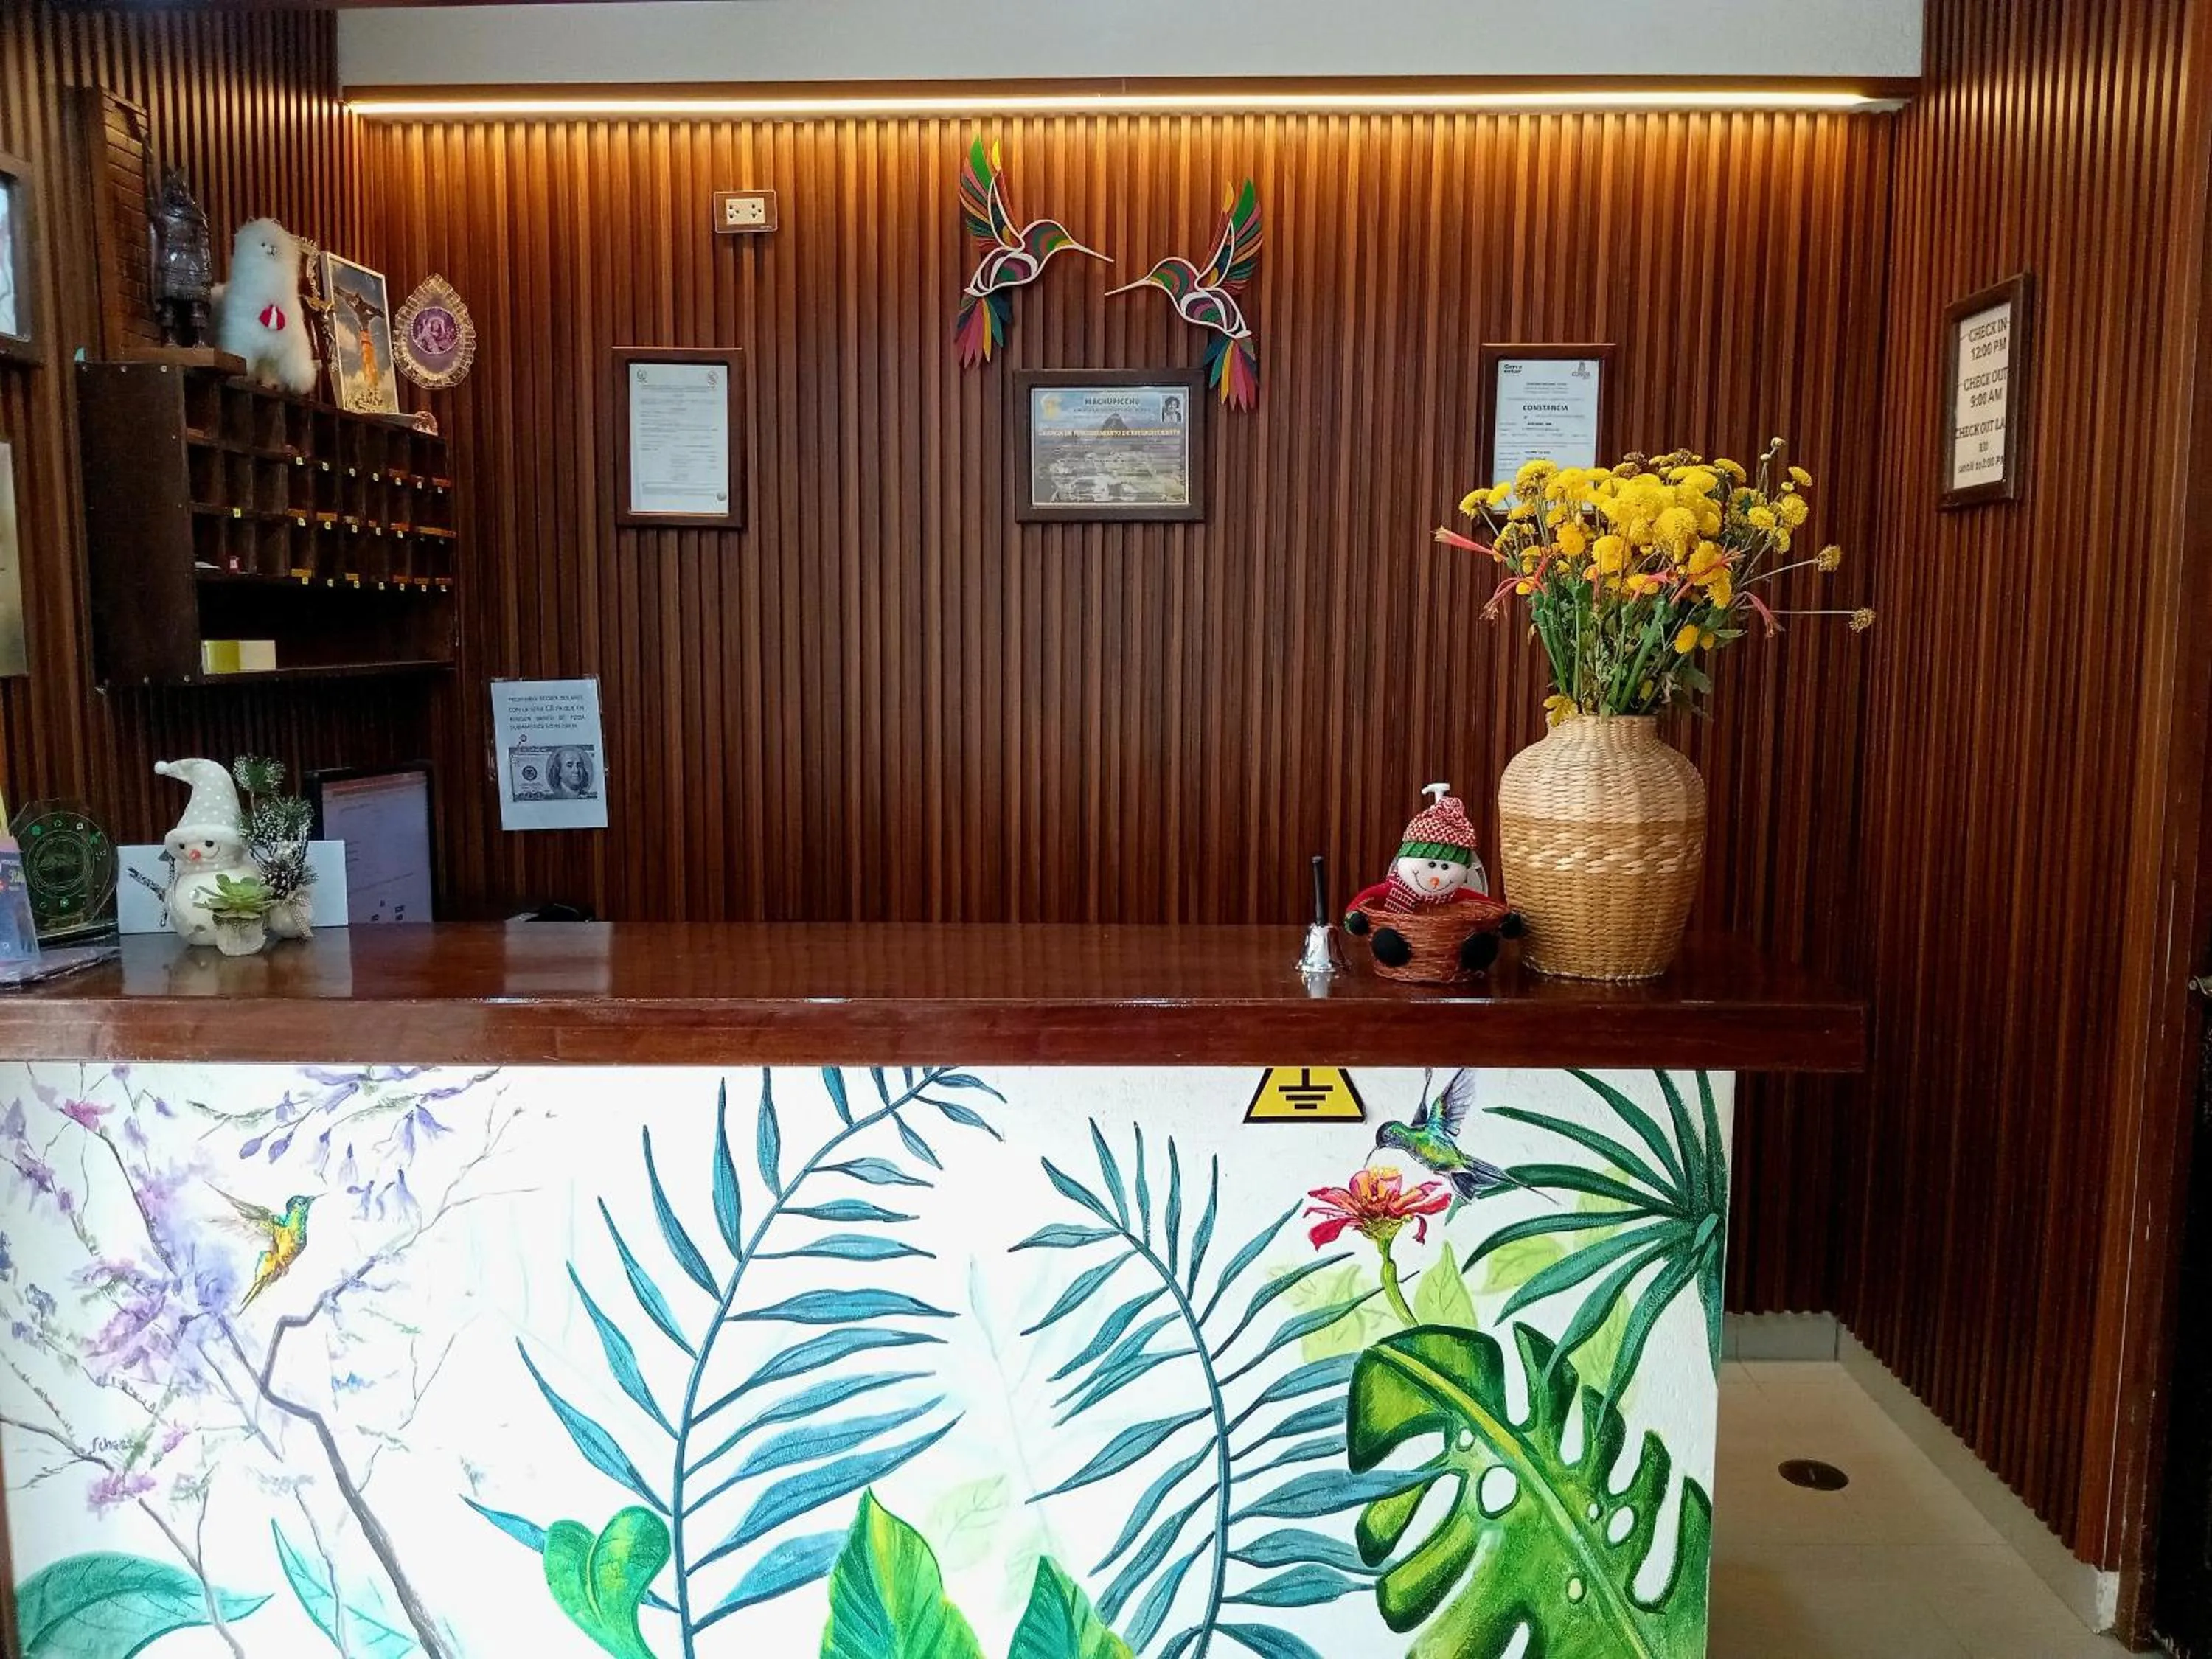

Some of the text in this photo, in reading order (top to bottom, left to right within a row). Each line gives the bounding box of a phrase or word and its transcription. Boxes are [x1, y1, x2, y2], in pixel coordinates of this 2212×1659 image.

[1969, 317, 2007, 342] CHECK IN
[1970, 337, 2006, 360] 12:00 PM
[1964, 372, 1991, 391] CHECK
[1989, 387, 2003, 402] AM
